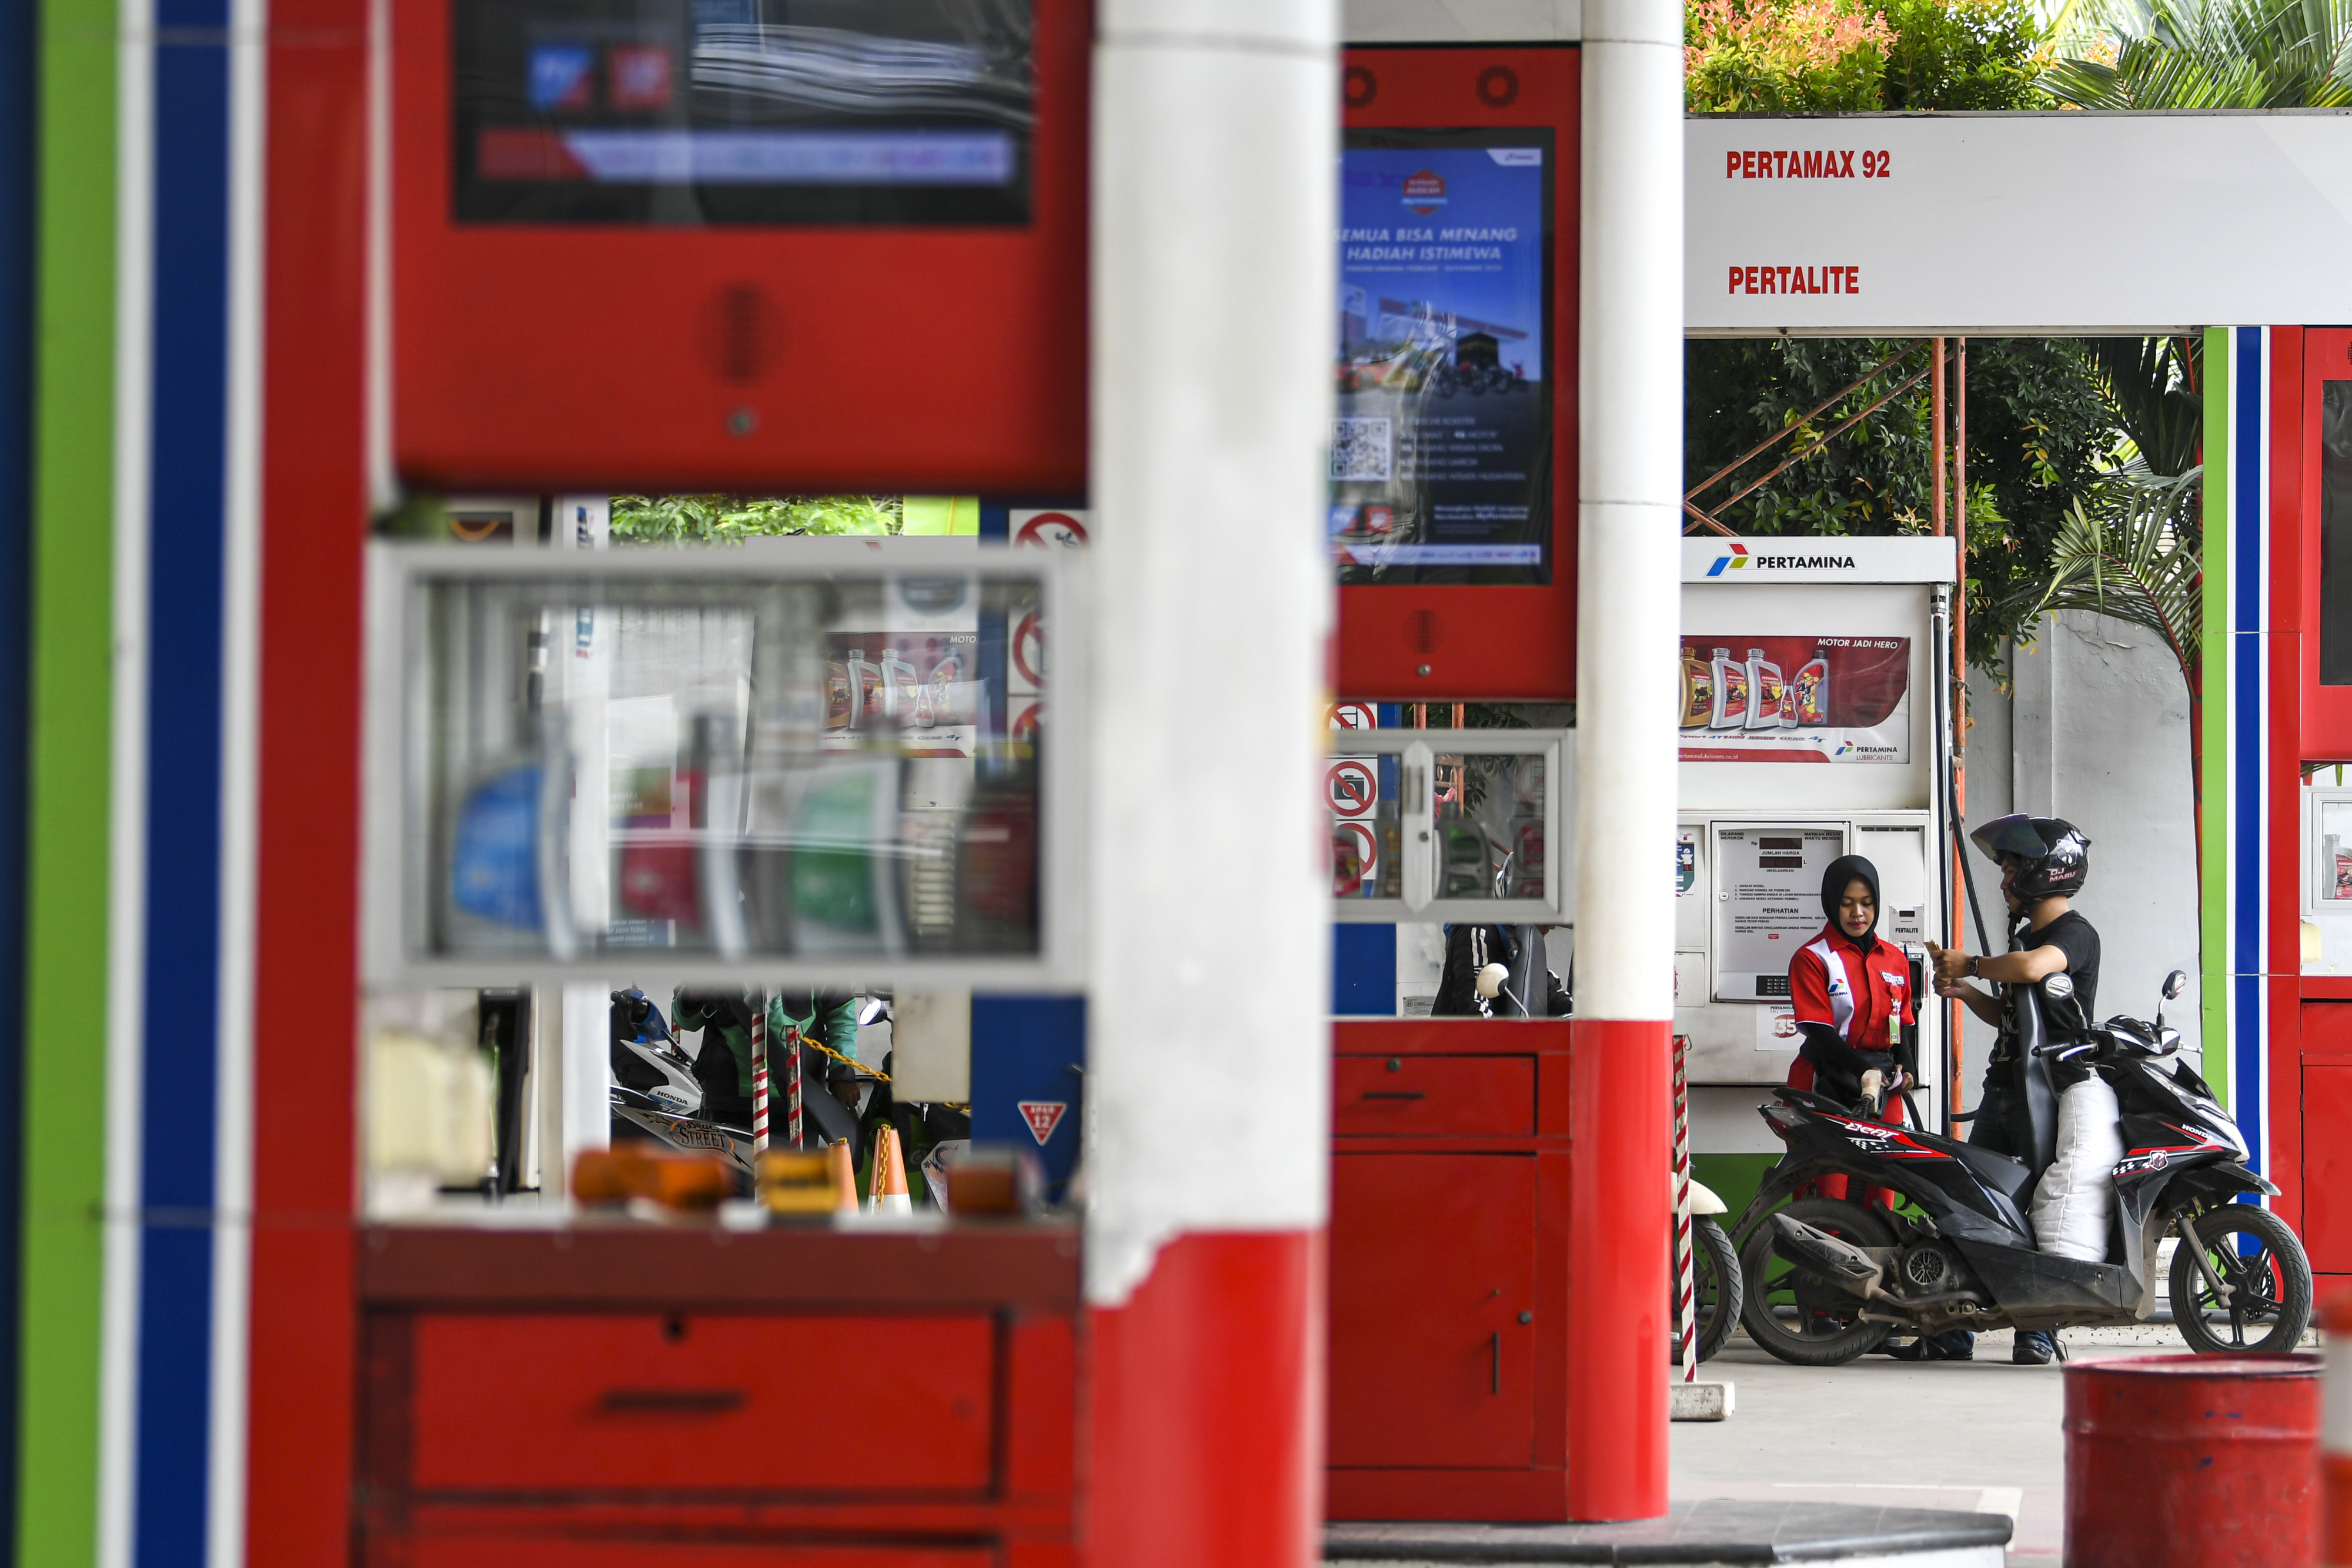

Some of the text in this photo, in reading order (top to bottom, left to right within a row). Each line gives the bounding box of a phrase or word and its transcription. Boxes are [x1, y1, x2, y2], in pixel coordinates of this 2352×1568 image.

[1726, 150, 1890, 178] PERTAMAX 92
[1332, 228, 1517, 242] SEMUA BISA MENANG
[1347, 247, 1501, 260] HADIAH ISTIMEWA
[1729, 266, 1859, 295] PERTALITE
[1757, 557, 1855, 568] PERTAMINA
[950, 636, 977, 644] MOTO
[1818, 638, 1850, 647] MOTOR
[1874, 640, 1897, 649] HERO
[2046, 867, 2064, 875] DJ
[2049, 871, 2076, 882] MARU
[657, 1091, 688, 1105] HONDA
[687, 1121, 717, 1131] Beat
[679, 1127, 726, 1148] STREET
[2181, 1124, 2214, 1142] HONDA
